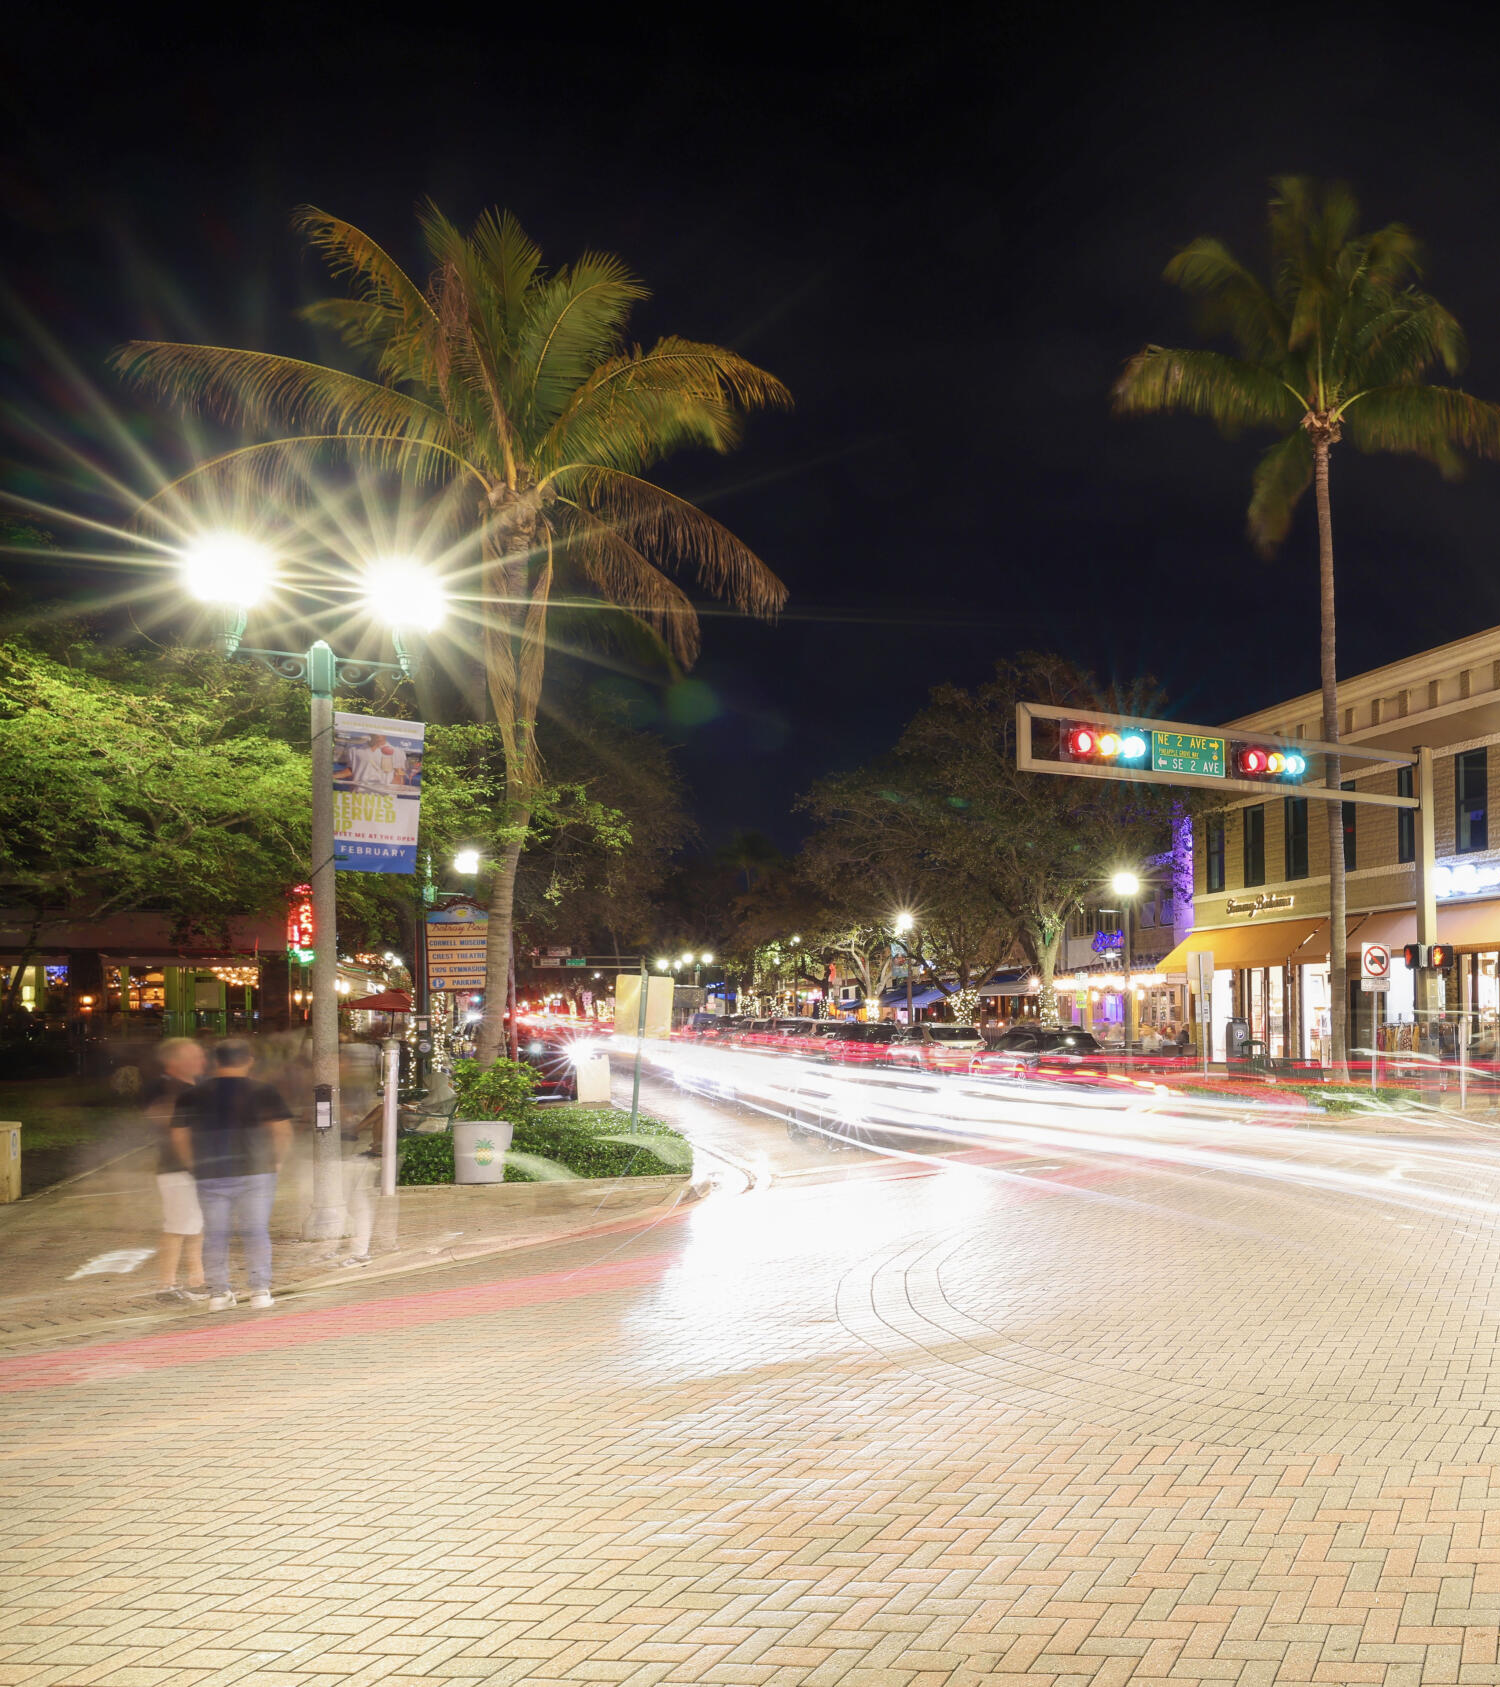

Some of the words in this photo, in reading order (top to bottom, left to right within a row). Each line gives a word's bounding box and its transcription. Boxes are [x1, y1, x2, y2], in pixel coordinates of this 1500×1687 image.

[1157, 733, 1169, 746] NE
[1176, 735, 1183, 747] 2
[1190, 737, 1207, 750] AVE
[1172, 758, 1184, 770] SE
[1190, 760, 1196, 771] 2
[1203, 761, 1220, 773] AVE
[340, 845, 406, 857] FEBRUARY
